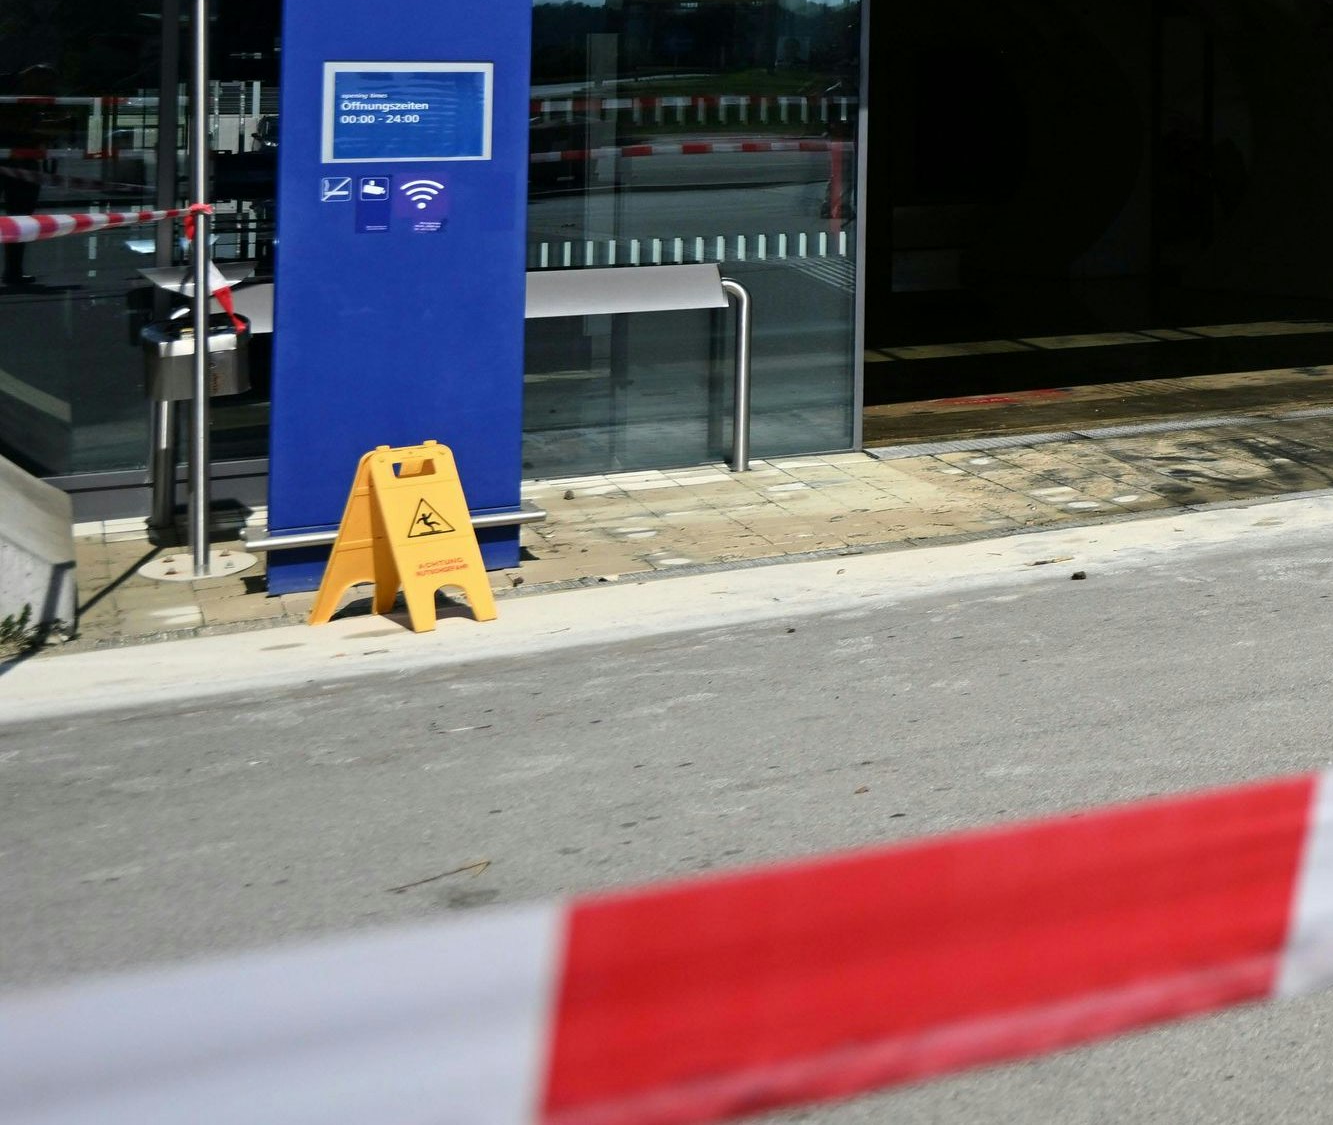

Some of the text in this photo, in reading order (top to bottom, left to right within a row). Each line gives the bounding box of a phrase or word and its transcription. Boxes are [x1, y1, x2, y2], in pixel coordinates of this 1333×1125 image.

[341, 101, 429, 113] Öffnungszeiten
[341, 115, 376, 124] 00:00
[385, 114, 420, 124] 24:00
